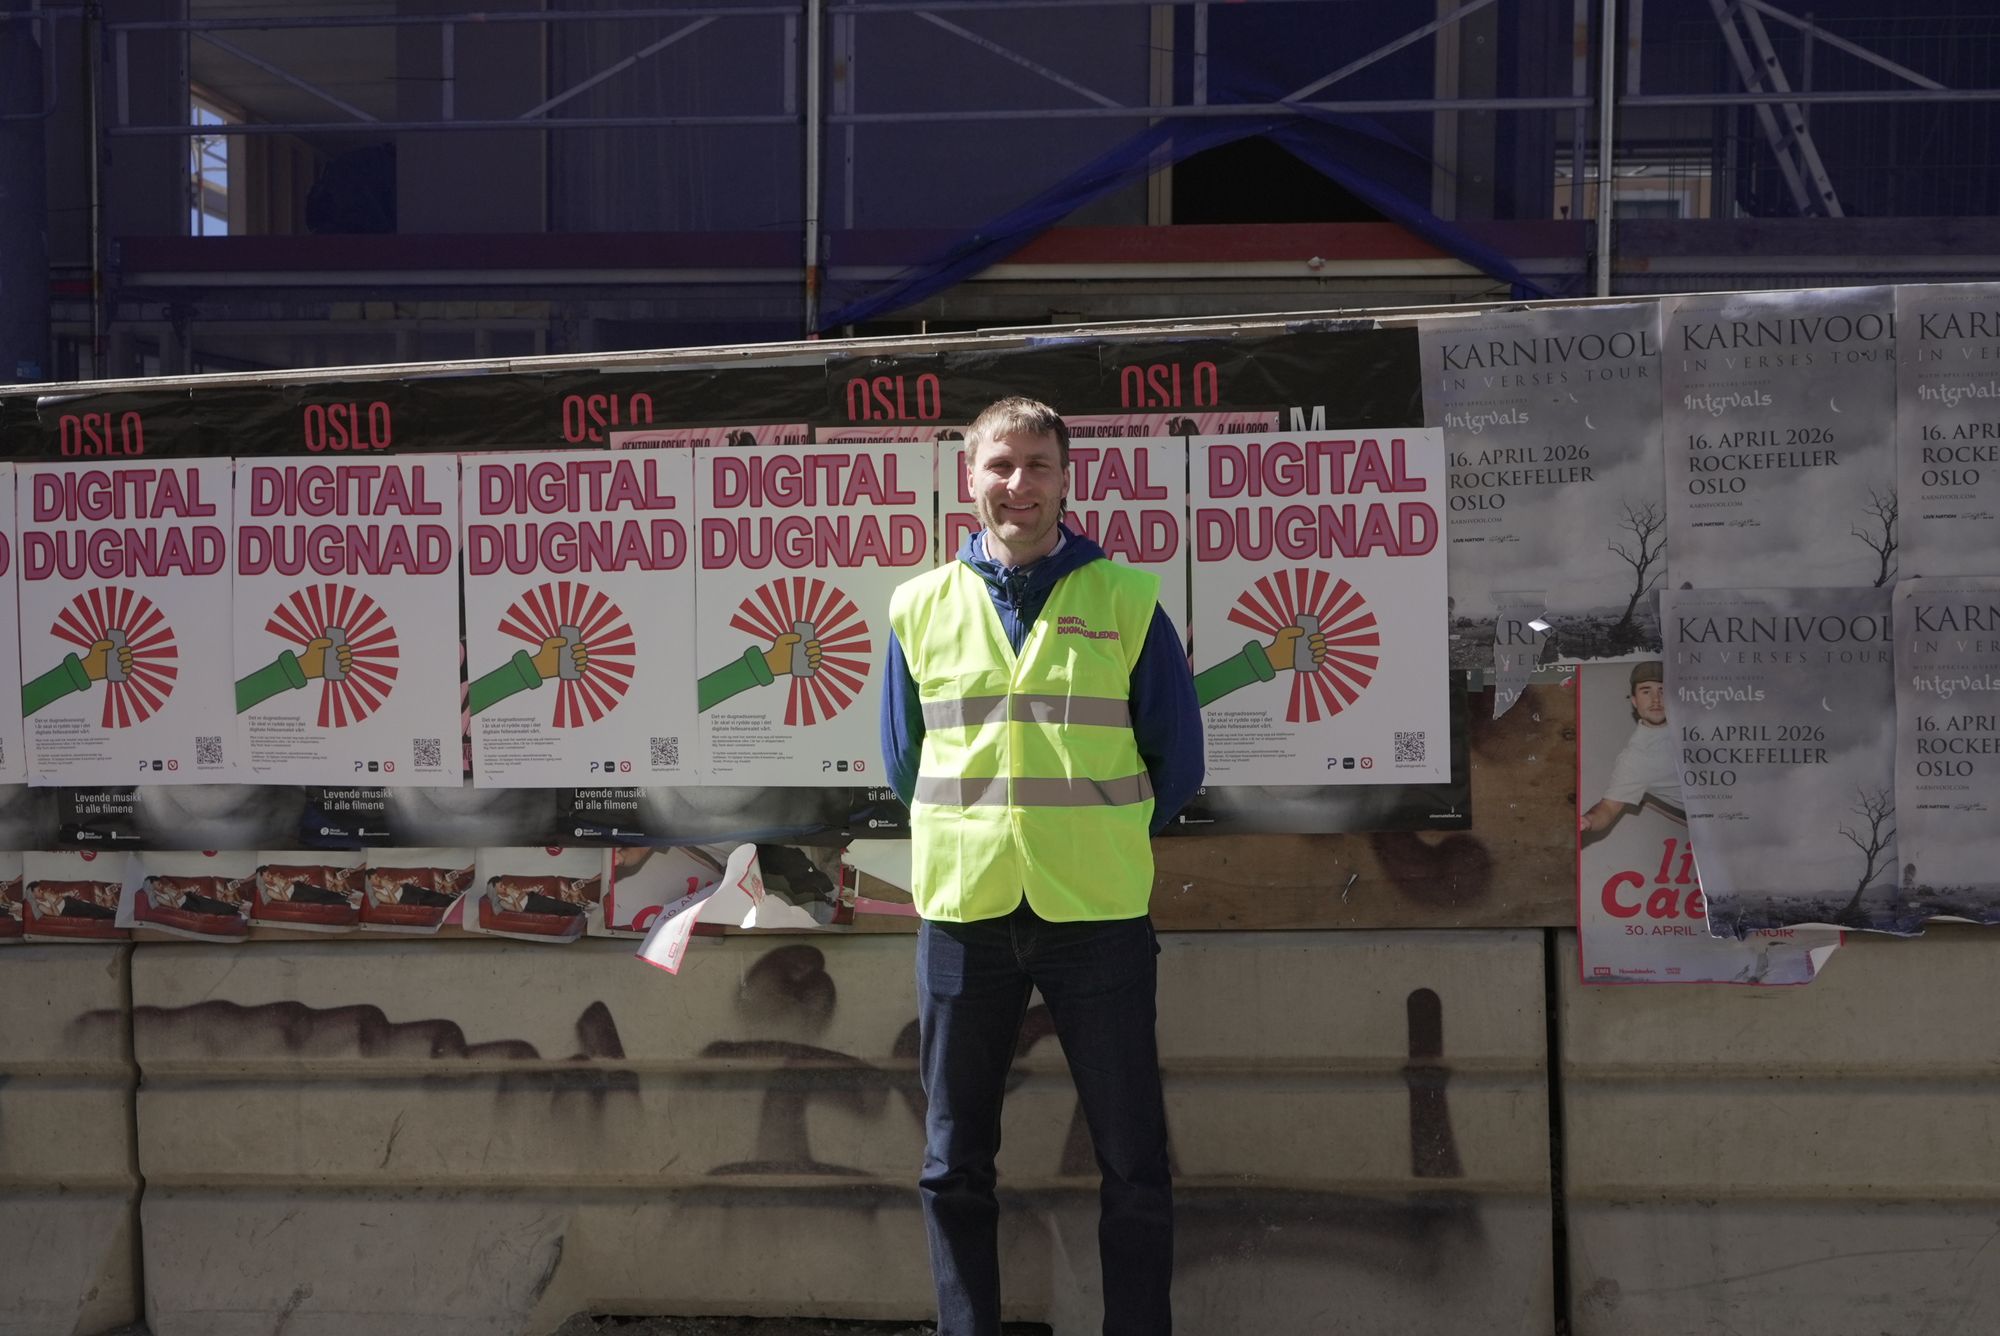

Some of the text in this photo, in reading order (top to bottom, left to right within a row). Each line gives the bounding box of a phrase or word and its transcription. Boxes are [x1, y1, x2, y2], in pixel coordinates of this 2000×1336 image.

[1682, 313, 1897, 351] KARNIVOOL
[1919, 311, 2000, 340] KAR
[1441, 331, 1656, 371] KARNIVOOL
[1683, 348, 1896, 372] IN VERSES TOUR
[1918, 348, 1943, 361] IN
[1120, 362, 1218, 408] OSLO
[1442, 366, 1649, 391] IN VERSES TOUR
[847, 373, 942, 421] OSLO
[1684, 390, 1773, 417] Intervals
[1918, 380, 2000, 408] Interval
[304, 401, 392, 452] OSLO
[562, 392, 653, 443] OSLO
[1445, 408, 1530, 434] Intervals
[58, 411, 144, 456] OSLO
[1688, 427, 1834, 450] 16. APRIL 2026
[1922, 425, 1946, 441] 16.
[1450, 445, 1590, 468] 16. APRIL 2026
[1689, 450, 1840, 473] ROCKEFELLER
[1922, 444, 2000, 464] ROCKE
[712, 453, 916, 508] DIGITAL
[1208, 439, 1426, 499] DIGITAL
[1450, 466, 1595, 489] ROCKEFELLER
[1922, 469, 1980, 487] OSLO
[33, 468, 216, 522] DIGITAL
[251, 465, 442, 516] DIGITAL
[479, 459, 676, 515] DIGITAL
[1689, 477, 1746, 495] OSLO
[1450, 493, 1505, 511] OSLO
[701, 515, 927, 569] DUGNAD
[944, 510, 1179, 563] DNAD
[1196, 502, 1438, 562] DUGNAD
[23, 526, 226, 580] DUGNAD
[238, 524, 452, 576] DUGNAD
[468, 518, 687, 575] DUGNAD
[1057, 616, 1087, 628] DIGITAL
[1678, 615, 1893, 643] KARNIVOOL
[1678, 651, 1889, 665] IN VERSES TOUR
[1914, 640, 1938, 653] IN
[1678, 685, 1765, 710] Intervals
[1682, 725, 1825, 742] 16. APRIL 2026
[1916, 715, 1997, 732] 16. APRI
[1682, 748, 1829, 764] ROCKEFELLER
[1684, 770, 1737, 786] OSLO
[1916, 760, 1974, 777] OSLO
[75, 792, 142, 803] Levende musikk
[323, 788, 393, 799] Levende musikk
[324, 800, 385, 810] til alle filmene
[575, 787, 647, 799] Levende musikk
[575, 799, 638, 810] til alle filmene
[868, 789, 897, 801] til alle
[75, 803, 133, 813] til alle filmene
[1654, 838, 1699, 884] li
[1625, 925, 1648, 936] 30.
[1652, 925, 1697, 936] APRIL
